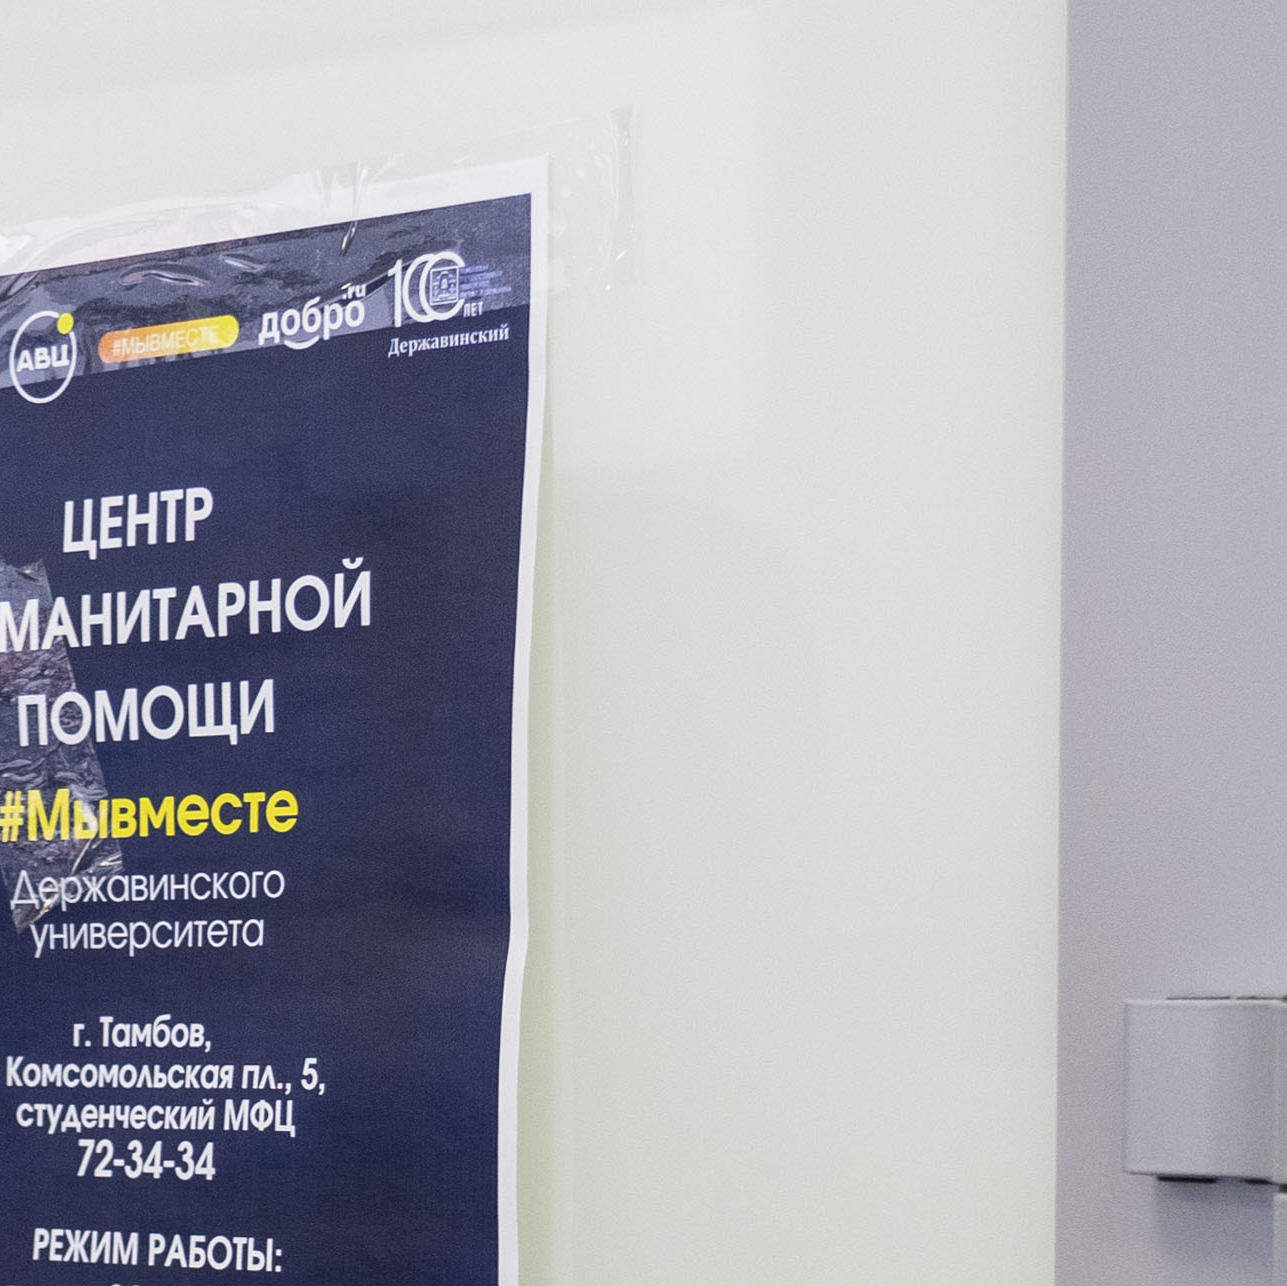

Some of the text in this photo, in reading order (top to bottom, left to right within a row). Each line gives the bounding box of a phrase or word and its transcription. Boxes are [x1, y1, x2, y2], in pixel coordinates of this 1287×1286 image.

[463, 301, 484, 318] ЛЕТ
[17, 344, 70, 372] АВЦ
[112, 324, 220, 357] #МЫВМЕСТЕ
[388, 323, 510, 358] Державинский
[62, 487, 214, 560] ЦЕНТР
[17, 678, 275, 746] ПОМОЩИ
[10, 868, 286, 912] Державинского
[29, 918, 265, 959] университета
[72, 1013, 212, 1053] г. Тамбов,
[5, 1055, 326, 1096] Комсомольская пл., 5,
[15, 1097, 296, 1138] студенческий МФЦ
[76, 1138, 216, 1181] 72-34-34
[32, 1227, 283, 1273] РЕЖИМ РАБОТЫ:
